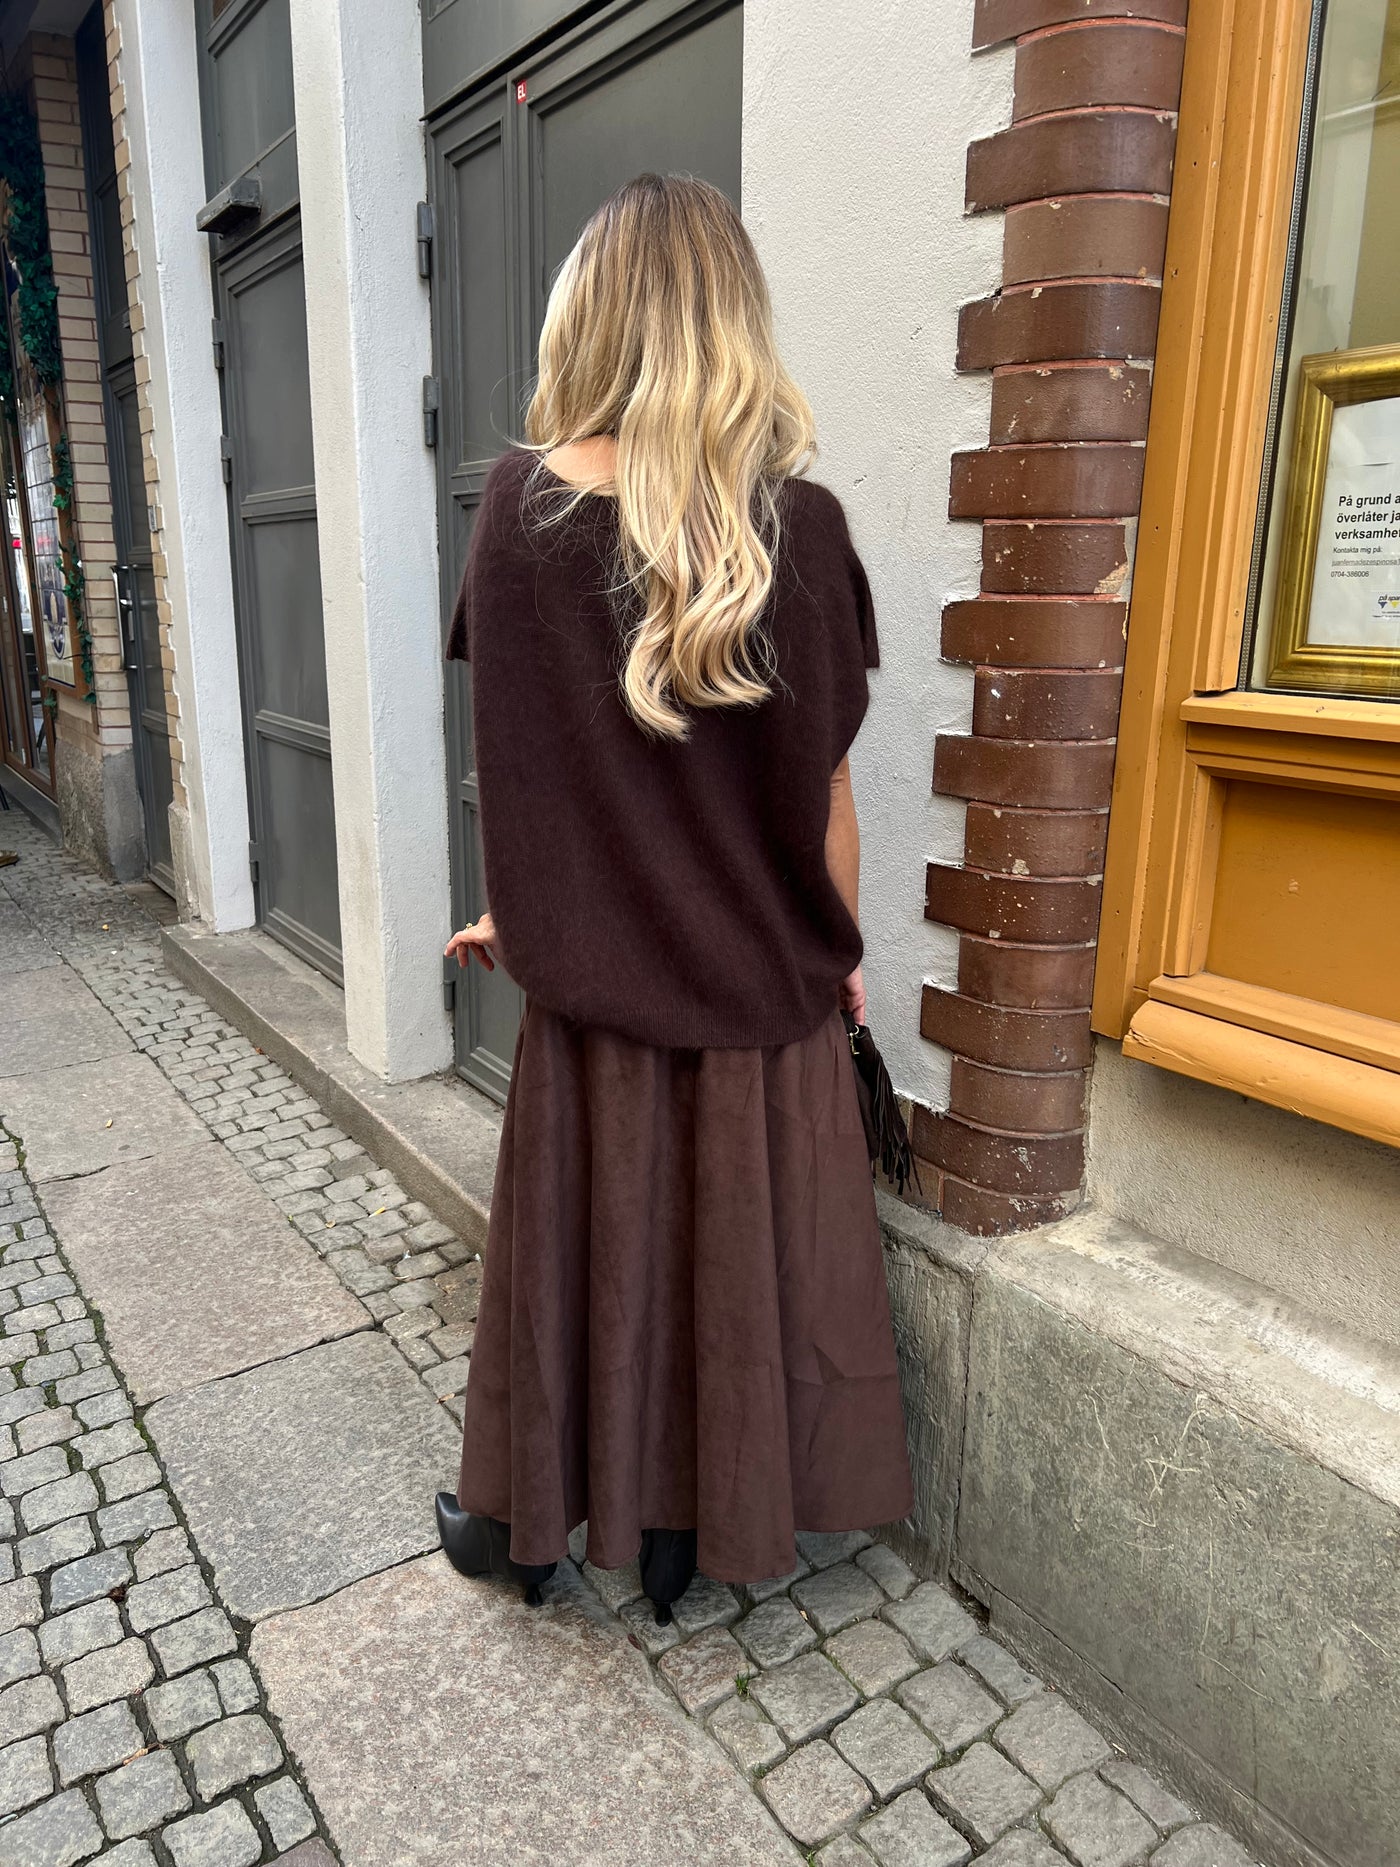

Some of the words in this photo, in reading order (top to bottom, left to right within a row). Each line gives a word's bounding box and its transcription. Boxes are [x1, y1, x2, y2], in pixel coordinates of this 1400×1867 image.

[518, 83, 526, 100] EL
[1338, 494, 1353, 506] På
[1356, 493, 1392, 508] grund
[1336, 510, 1389, 523] överlåter
